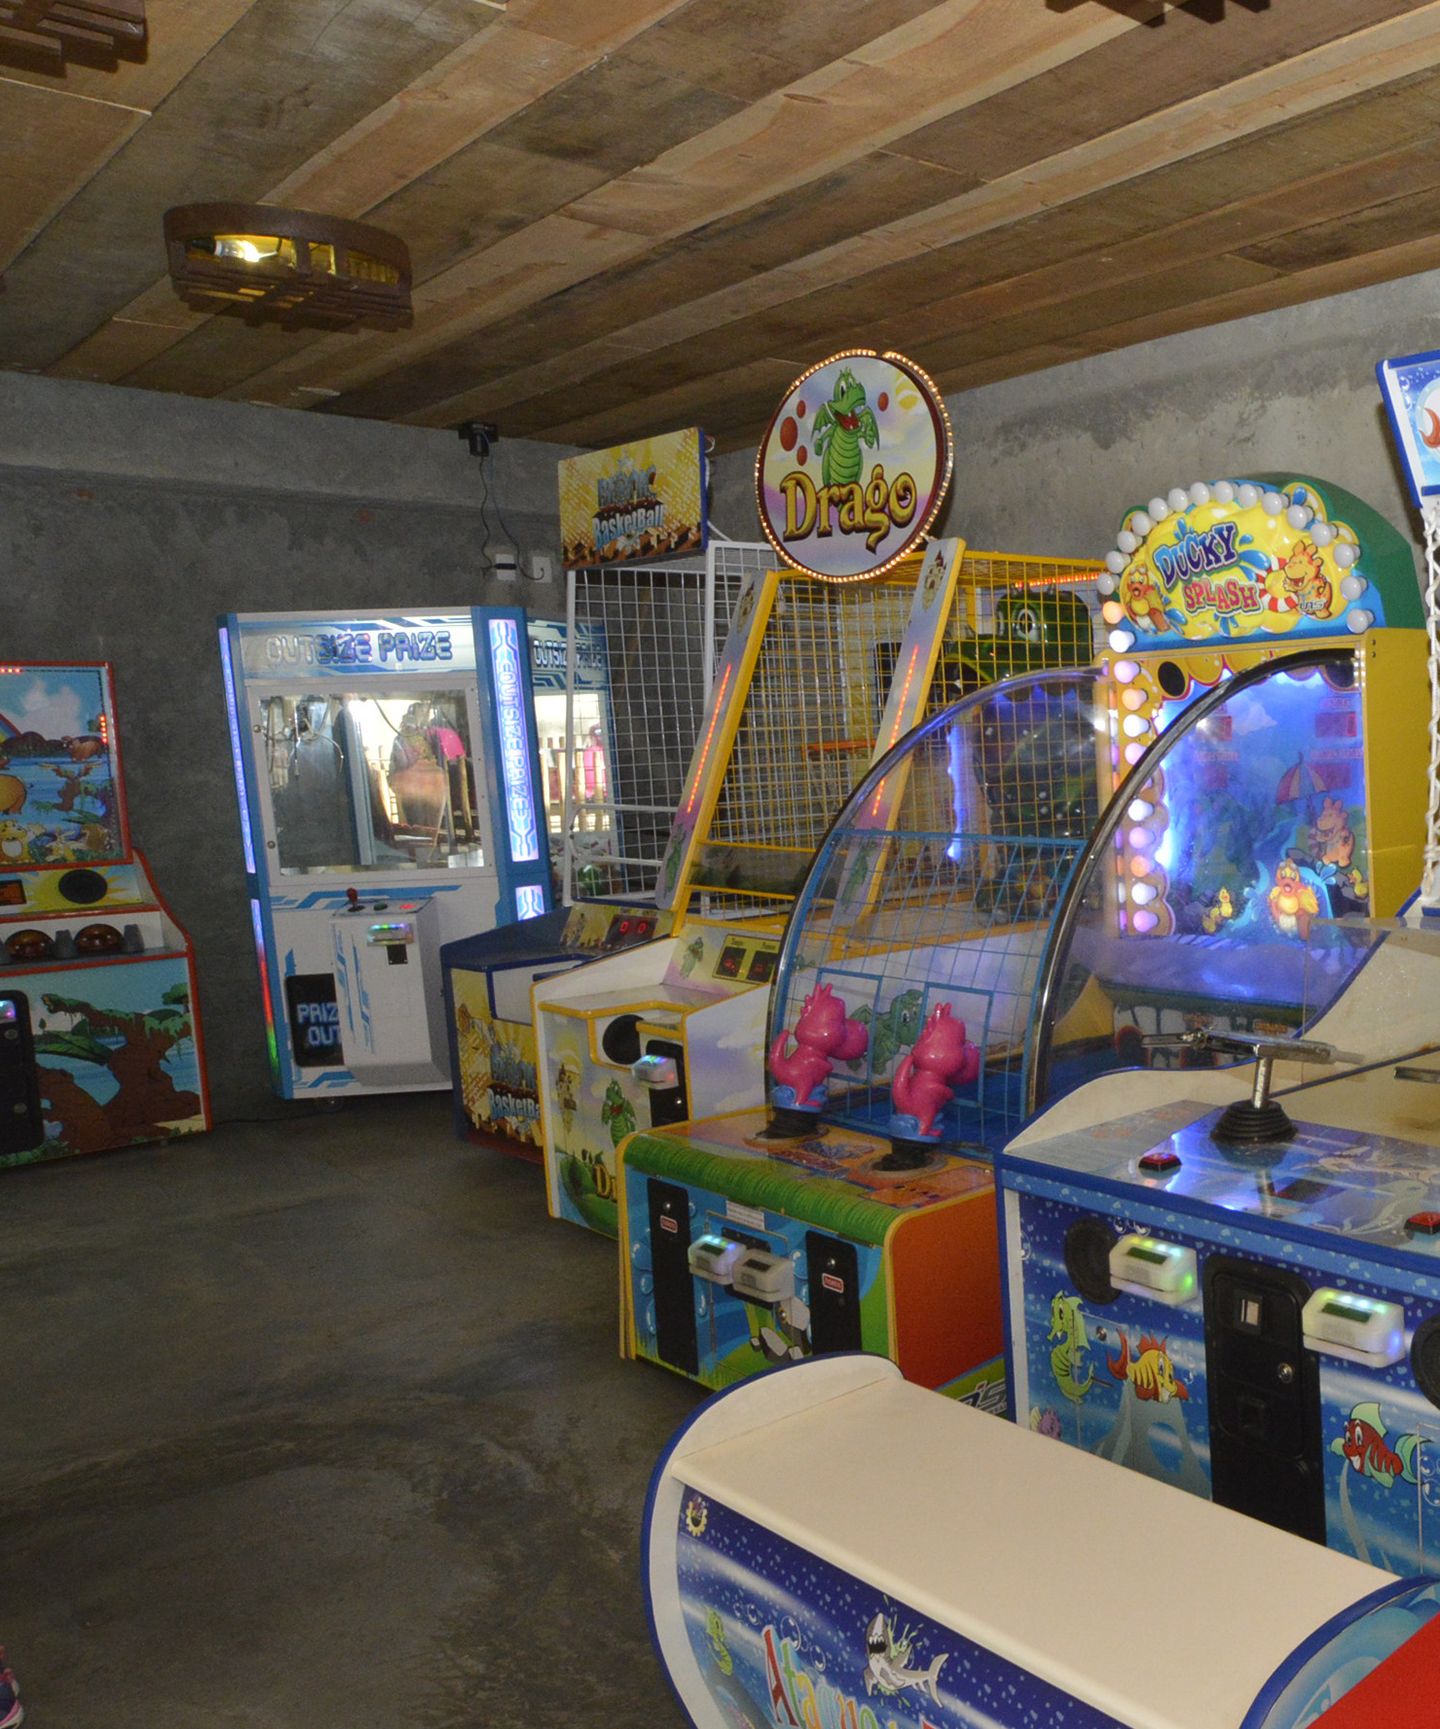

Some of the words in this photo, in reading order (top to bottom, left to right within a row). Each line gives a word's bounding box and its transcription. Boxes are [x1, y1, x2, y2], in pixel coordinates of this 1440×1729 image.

[592, 504, 665, 552] BasketBall
[779, 463, 918, 556] Drago
[1153, 521, 1239, 592] DUCKY
[1182, 576, 1264, 617] SPLASH
[265, 634, 373, 665] OUTSIZE
[377, 630, 453, 663] PRIZE
[296, 1001, 338, 1024] PRIZ
